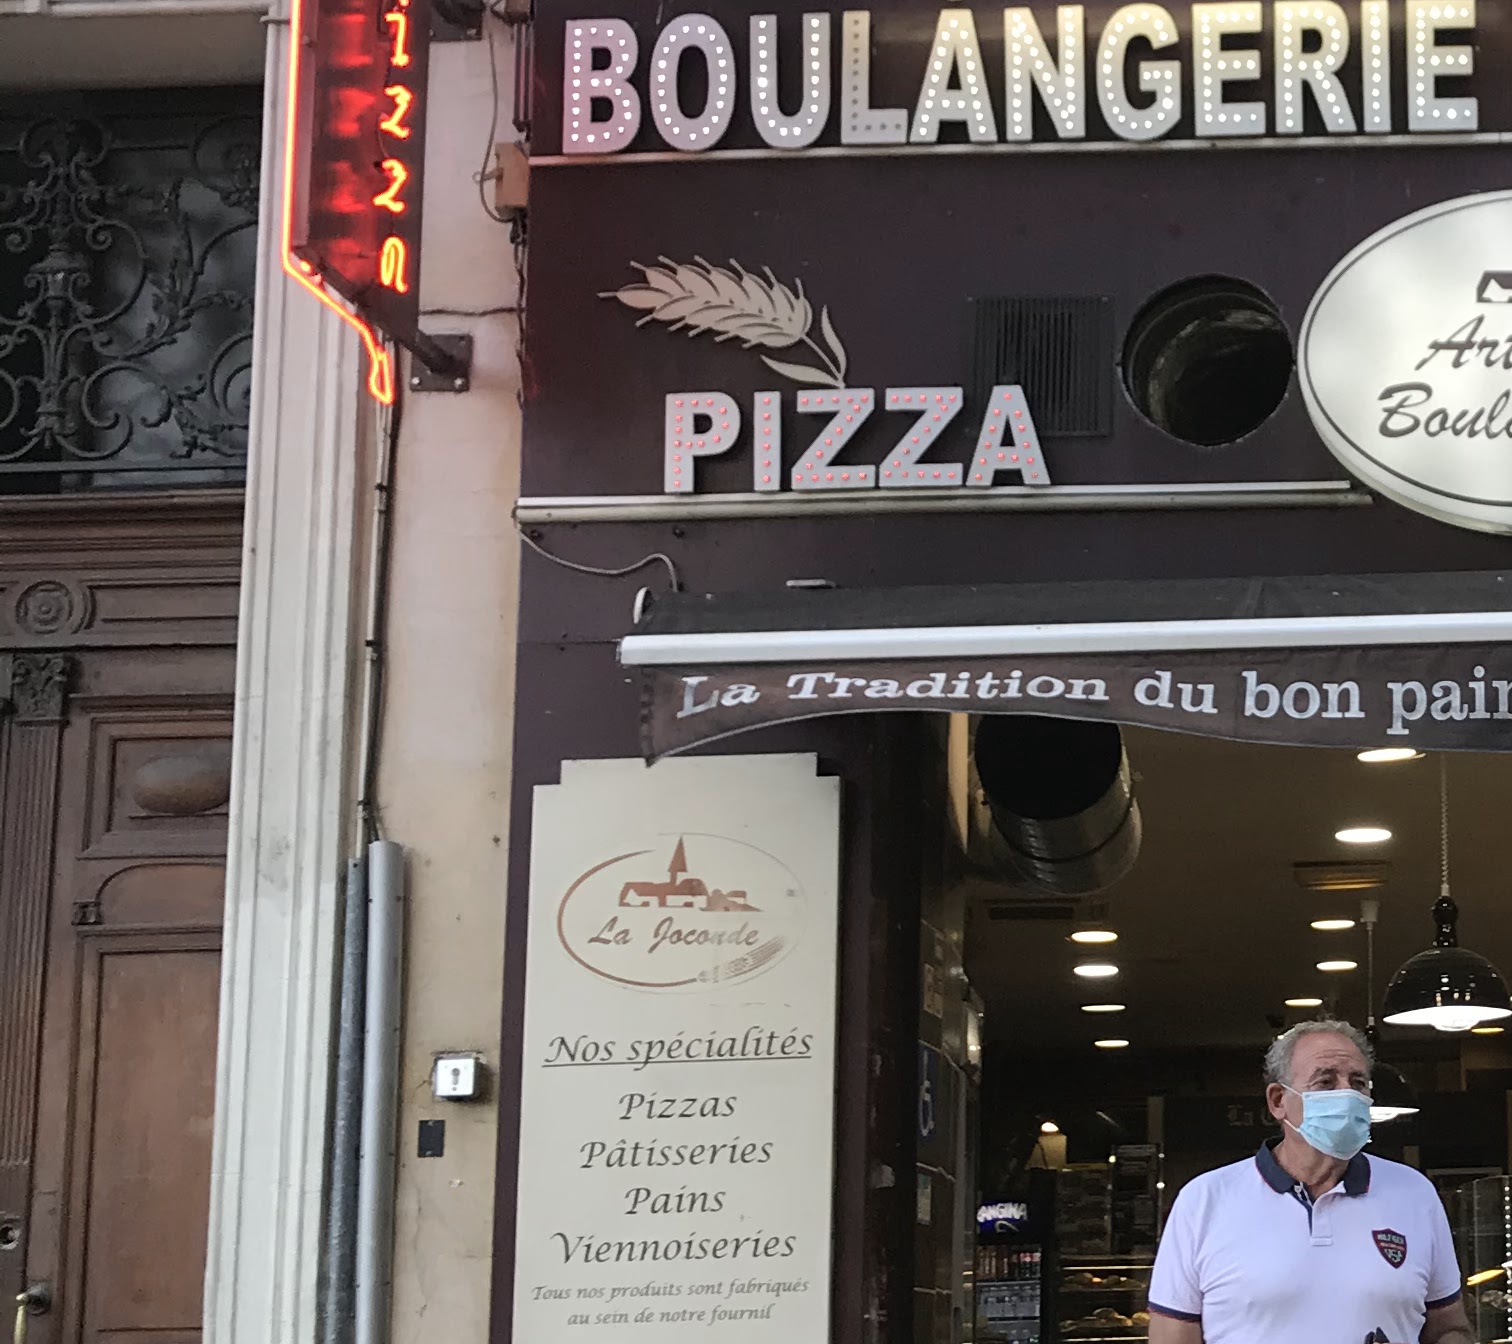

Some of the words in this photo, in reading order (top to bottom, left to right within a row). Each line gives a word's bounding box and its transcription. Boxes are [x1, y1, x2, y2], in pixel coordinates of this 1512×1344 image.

[663, 384, 1052, 493] PIZZA
[676, 675, 760, 720] La
[787, 669, 1110, 702] Tradition
[1132, 670, 1219, 714] du
[1243, 670, 1366, 720] bon
[587, 916, 632, 945] La
[647, 916, 759, 954] Joconde
[544, 1034, 616, 1063] Nos
[625, 1025, 814, 1071] spécialités
[617, 1090, 738, 1120] Pizzas
[579, 1136, 774, 1169] Pâtisseries
[623, 1185, 727, 1215] Pains
[550, 1229, 797, 1264] Viennoiseries
[531, 1284, 571, 1301] Tous
[576, 1286, 605, 1299] nos
[605, 1279, 682, 1303] produits
[687, 1281, 723, 1297] sont
[724, 1276, 810, 1300] fabriqués
[567, 1312, 590, 1325] au
[593, 1308, 629, 1325] sein
[633, 1307, 654, 1324] de
[659, 1308, 705, 1323] notre
[707, 1302, 775, 1326] fournil
